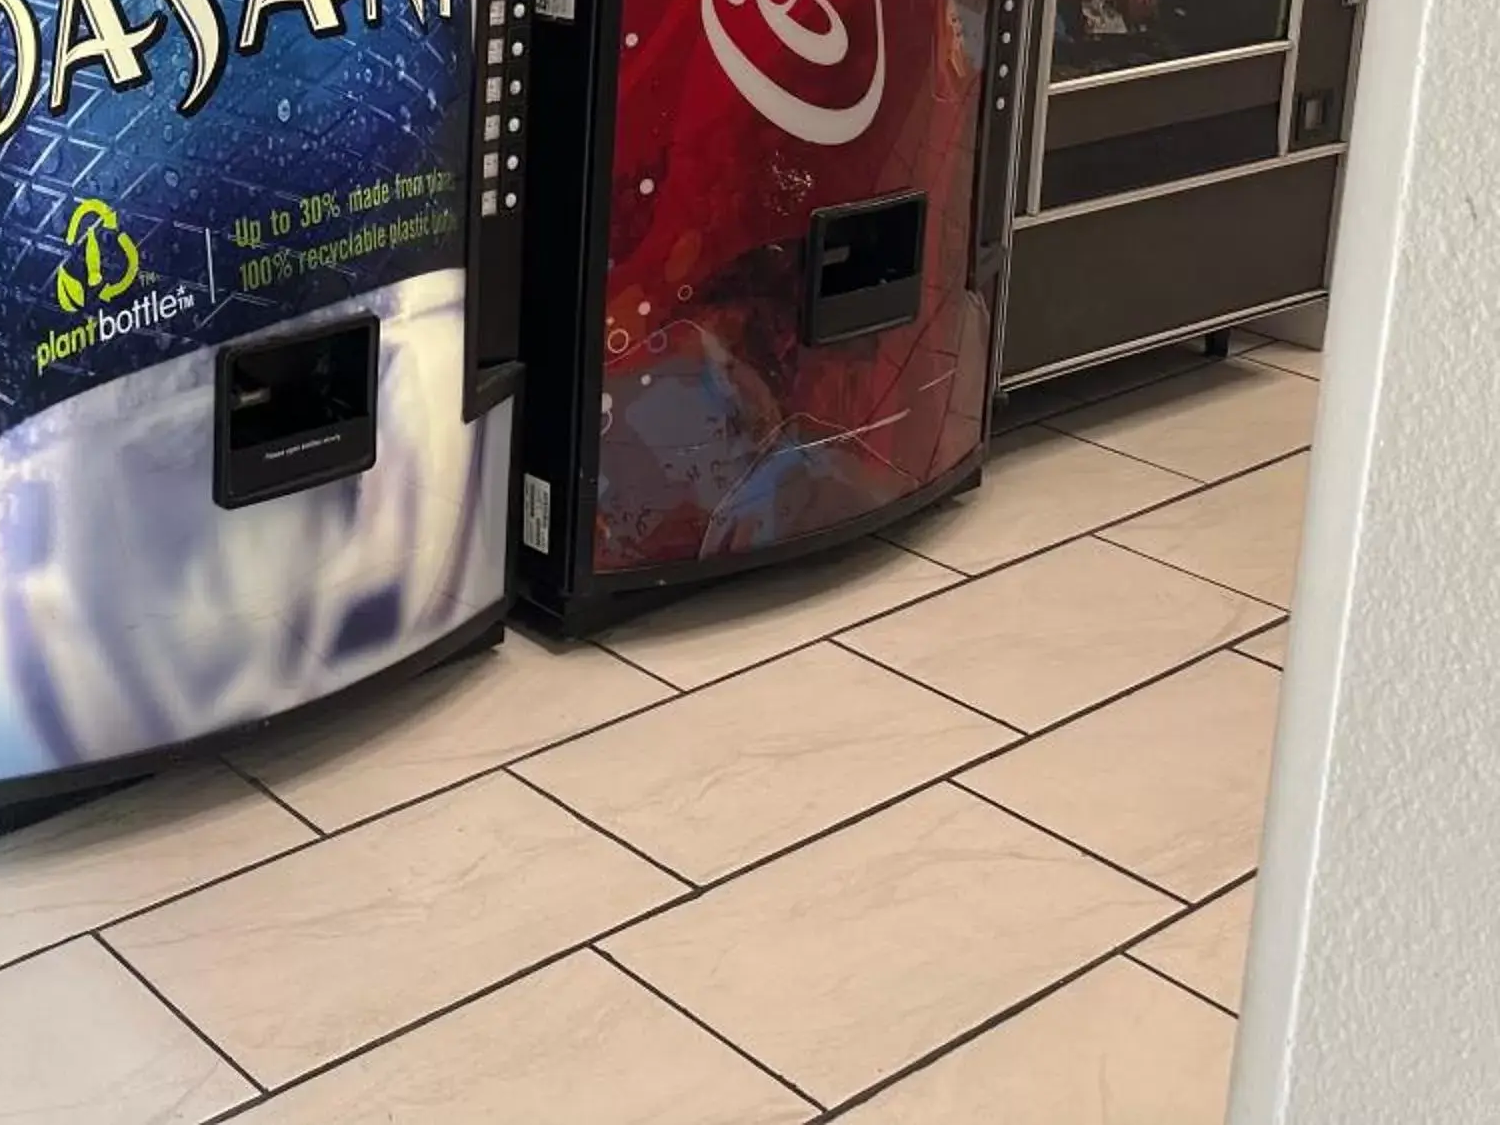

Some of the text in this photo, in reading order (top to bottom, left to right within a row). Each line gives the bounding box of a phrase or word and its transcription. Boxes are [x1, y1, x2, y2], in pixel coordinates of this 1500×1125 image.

[234, 216, 262, 250] Up
[269, 209, 291, 236] to
[299, 189, 341, 228] 30%
[348, 179, 390, 213] made
[395, 173, 422, 200] from
[239, 247, 294, 292] 100%
[299, 221, 387, 274] recyclable
[388, 209, 430, 249] plastic
[36, 290, 177, 377] plantbottle
